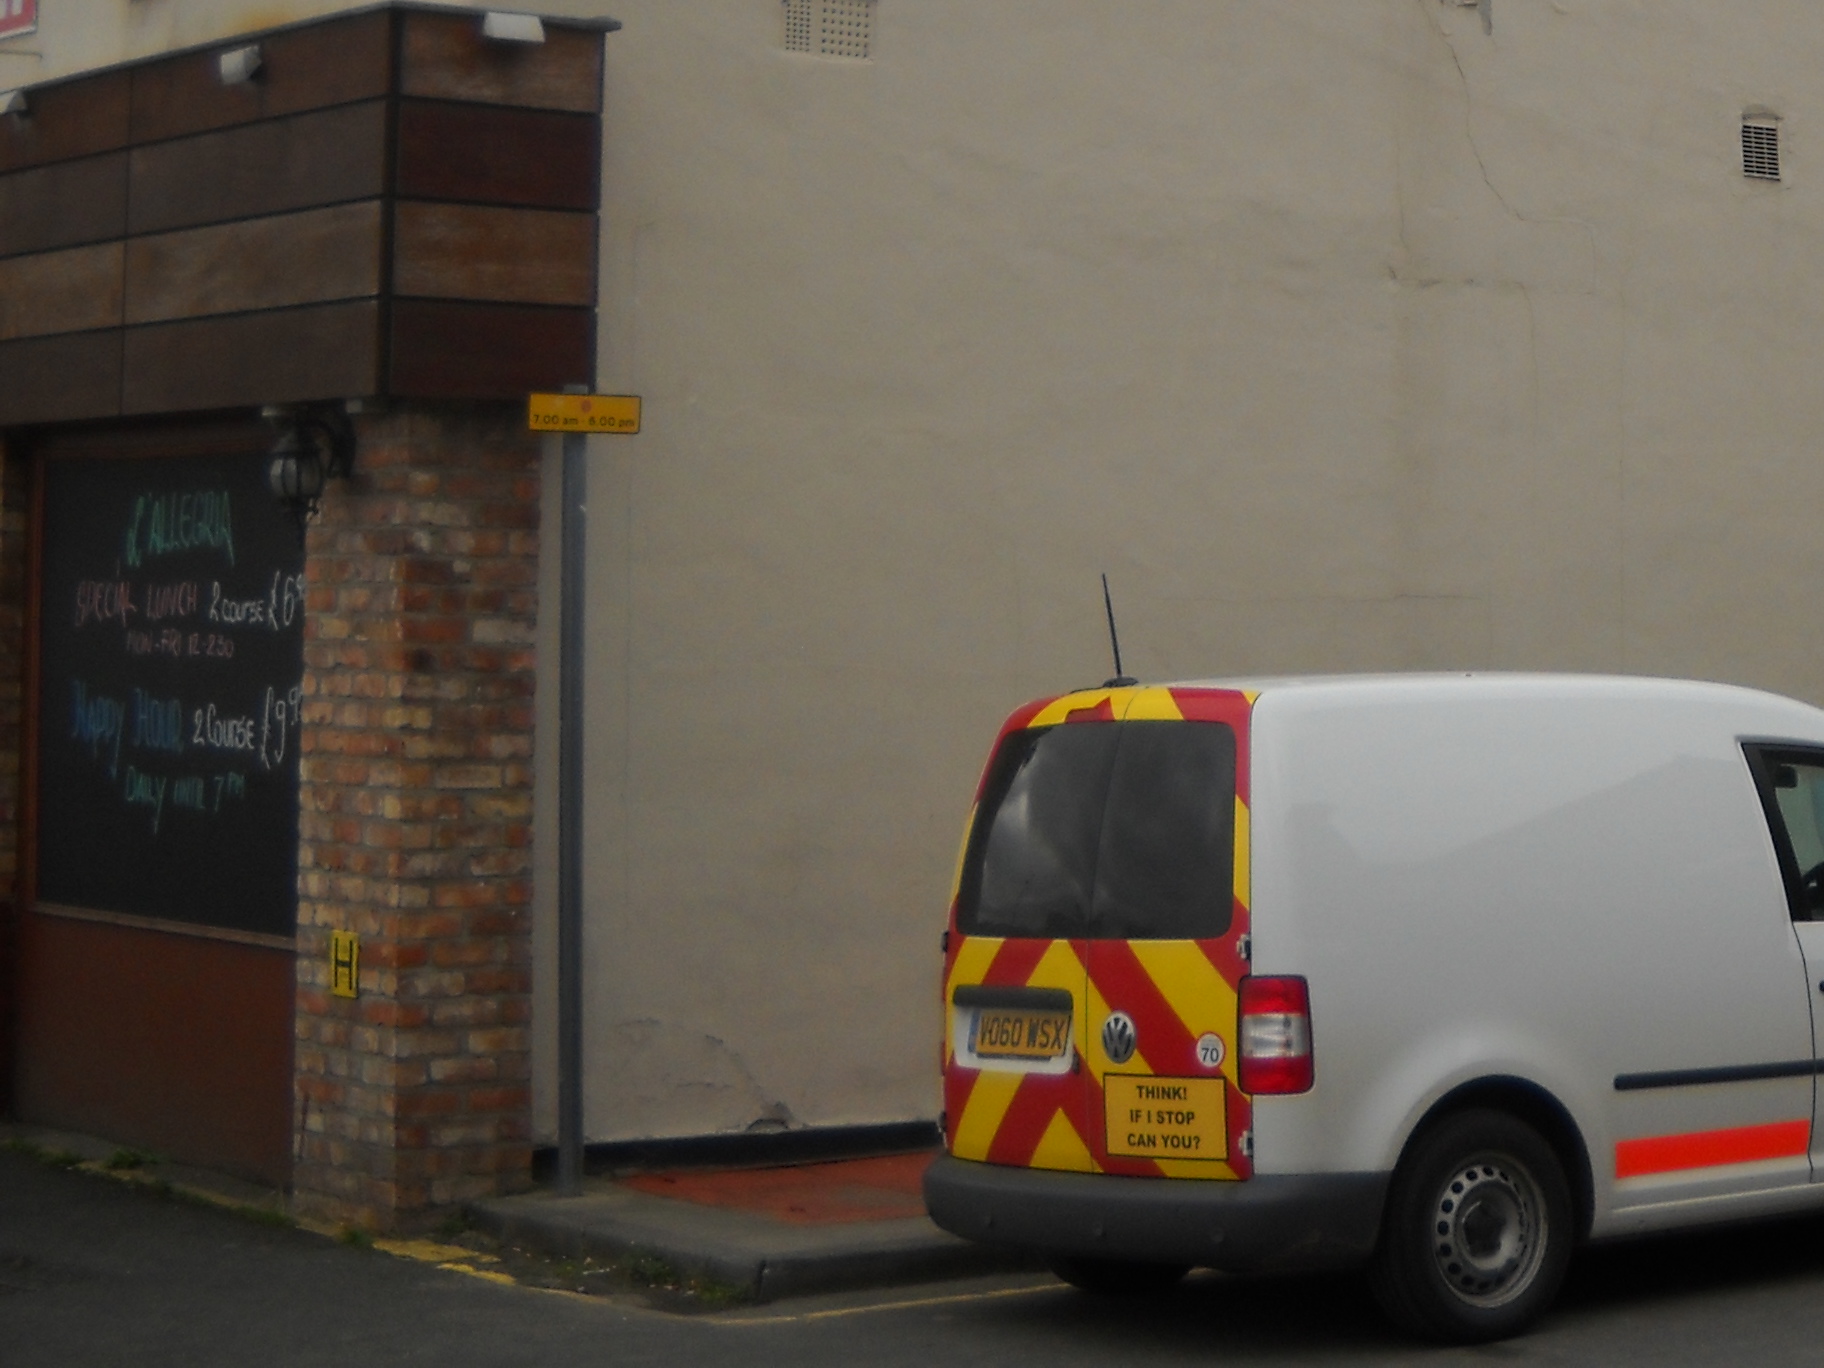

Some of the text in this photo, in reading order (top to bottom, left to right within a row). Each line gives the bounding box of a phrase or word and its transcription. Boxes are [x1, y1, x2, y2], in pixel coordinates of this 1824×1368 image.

[333, 936, 354, 992] H
[1201, 1047, 1220, 1063] 70
[1136, 1085, 1188, 1101] THINK!
[1129, 1109, 1195, 1125] IF I STOP
[1127, 1133, 1201, 1150] CAN YOU?
